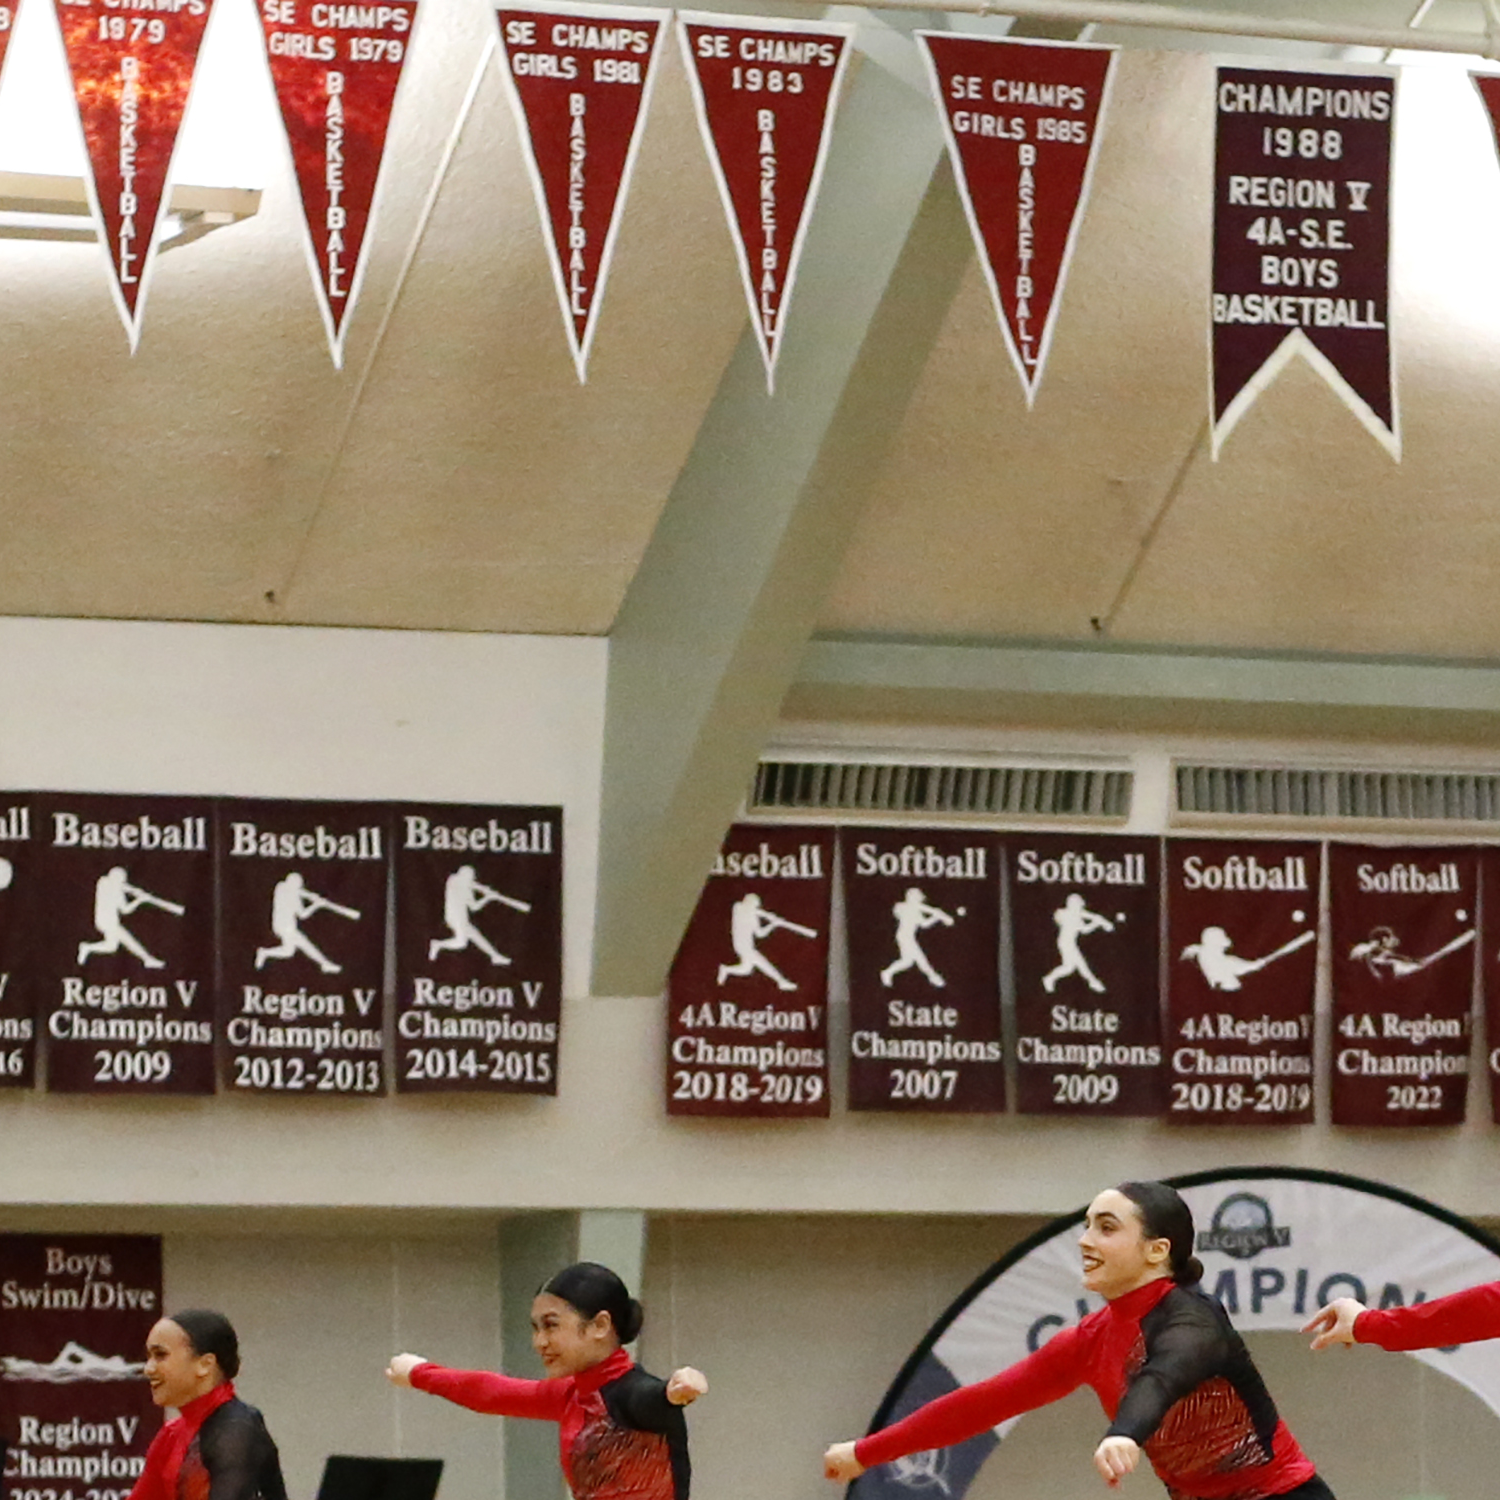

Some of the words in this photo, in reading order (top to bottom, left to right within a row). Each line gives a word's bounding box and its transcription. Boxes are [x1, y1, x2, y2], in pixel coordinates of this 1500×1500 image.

[99, 17, 165, 44] 1979
[264, 0, 295, 25] SE
[312, 4, 409, 32] CHAMPS
[269, 36, 335, 60] GIRLS
[350, 37, 402, 62] 1979
[506, 21, 537, 46] SE
[552, 24, 648, 54] CHAMPS
[698, 35, 730, 59] SE
[739, 38, 835, 67] CHAMPS
[513, 53, 576, 79] GIRLS
[593, 59, 641, 84] 1981
[732, 66, 803, 93] 1983
[951, 76, 982, 100] SE
[992, 80, 1085, 110] CHAMPS
[1219, 81, 1390, 121] CHAMPIONS
[953, 111, 1025, 139] GIRLS
[1037, 118, 1087, 144] 1985
[1263, 127, 1343, 160] 1988
[326, 71, 345, 297] BASKETBALL
[1229, 175, 1335, 210] REGION
[1346, 181, 1371, 211] V
[758, 110, 776, 337] BASKETBALL
[1247, 217, 1353, 250] 4A-S.E.
[1018, 144, 1037, 365] BASKETBALL
[1261, 255, 1338, 288] BOYS
[1213, 293, 1385, 328] BASKETBALL
[52, 813, 206, 851] Baseball
[230, 822, 382, 860] Baseball
[404, 816, 552, 854] Baseball
[709, 843, 823, 879] aseball
[856, 842, 986, 879] Softball
[1017, 850, 1145, 885] Softball
[1183, 856, 1308, 892] Softball
[1357, 863, 1459, 894] Softball
[62, 978, 168, 1011] Region
[176, 981, 198, 1007] V
[243, 985, 346, 1018] Region
[354, 989, 376, 1016] V
[414, 978, 515, 1008] Region
[521, 982, 543, 1008] V
[48, 1011, 212, 1044] Champions
[398, 1011, 556, 1044] Champions
[679, 1003, 715, 1028] 4A
[718, 1001, 805, 1035] Region
[889, 1001, 957, 1028] State
[1051, 1006, 1119, 1034] State
[1180, 1016, 1214, 1040] 4A
[1218, 1014, 1298, 1046] Region
[1339, 1014, 1376, 1038] 4A
[1382, 1012, 1460, 1045] Region
[227, 1018, 382, 1053] Champions
[852, 1031, 1000, 1065] Champions
[94, 1051, 171, 1082] 2009
[405, 1048, 551, 1082] 2014-2015
[672, 1036, 825, 1071] Champions
[1018, 1037, 1161, 1068] Champions
[1337, 1048, 1468, 1080] Champion
[234, 1057, 380, 1091] 2012-2013
[673, 1071, 823, 1103] 2018-2019
[890, 1070, 957, 1100] 2007
[1054, 1074, 1120, 1104] 2009
[1171, 1082, 1311, 1112] 2018-2019
[46, 1247, 112, 1286] Boys
[1, 1280, 155, 1311] Swim/Dive
[19, 1416, 115, 1451] Region
